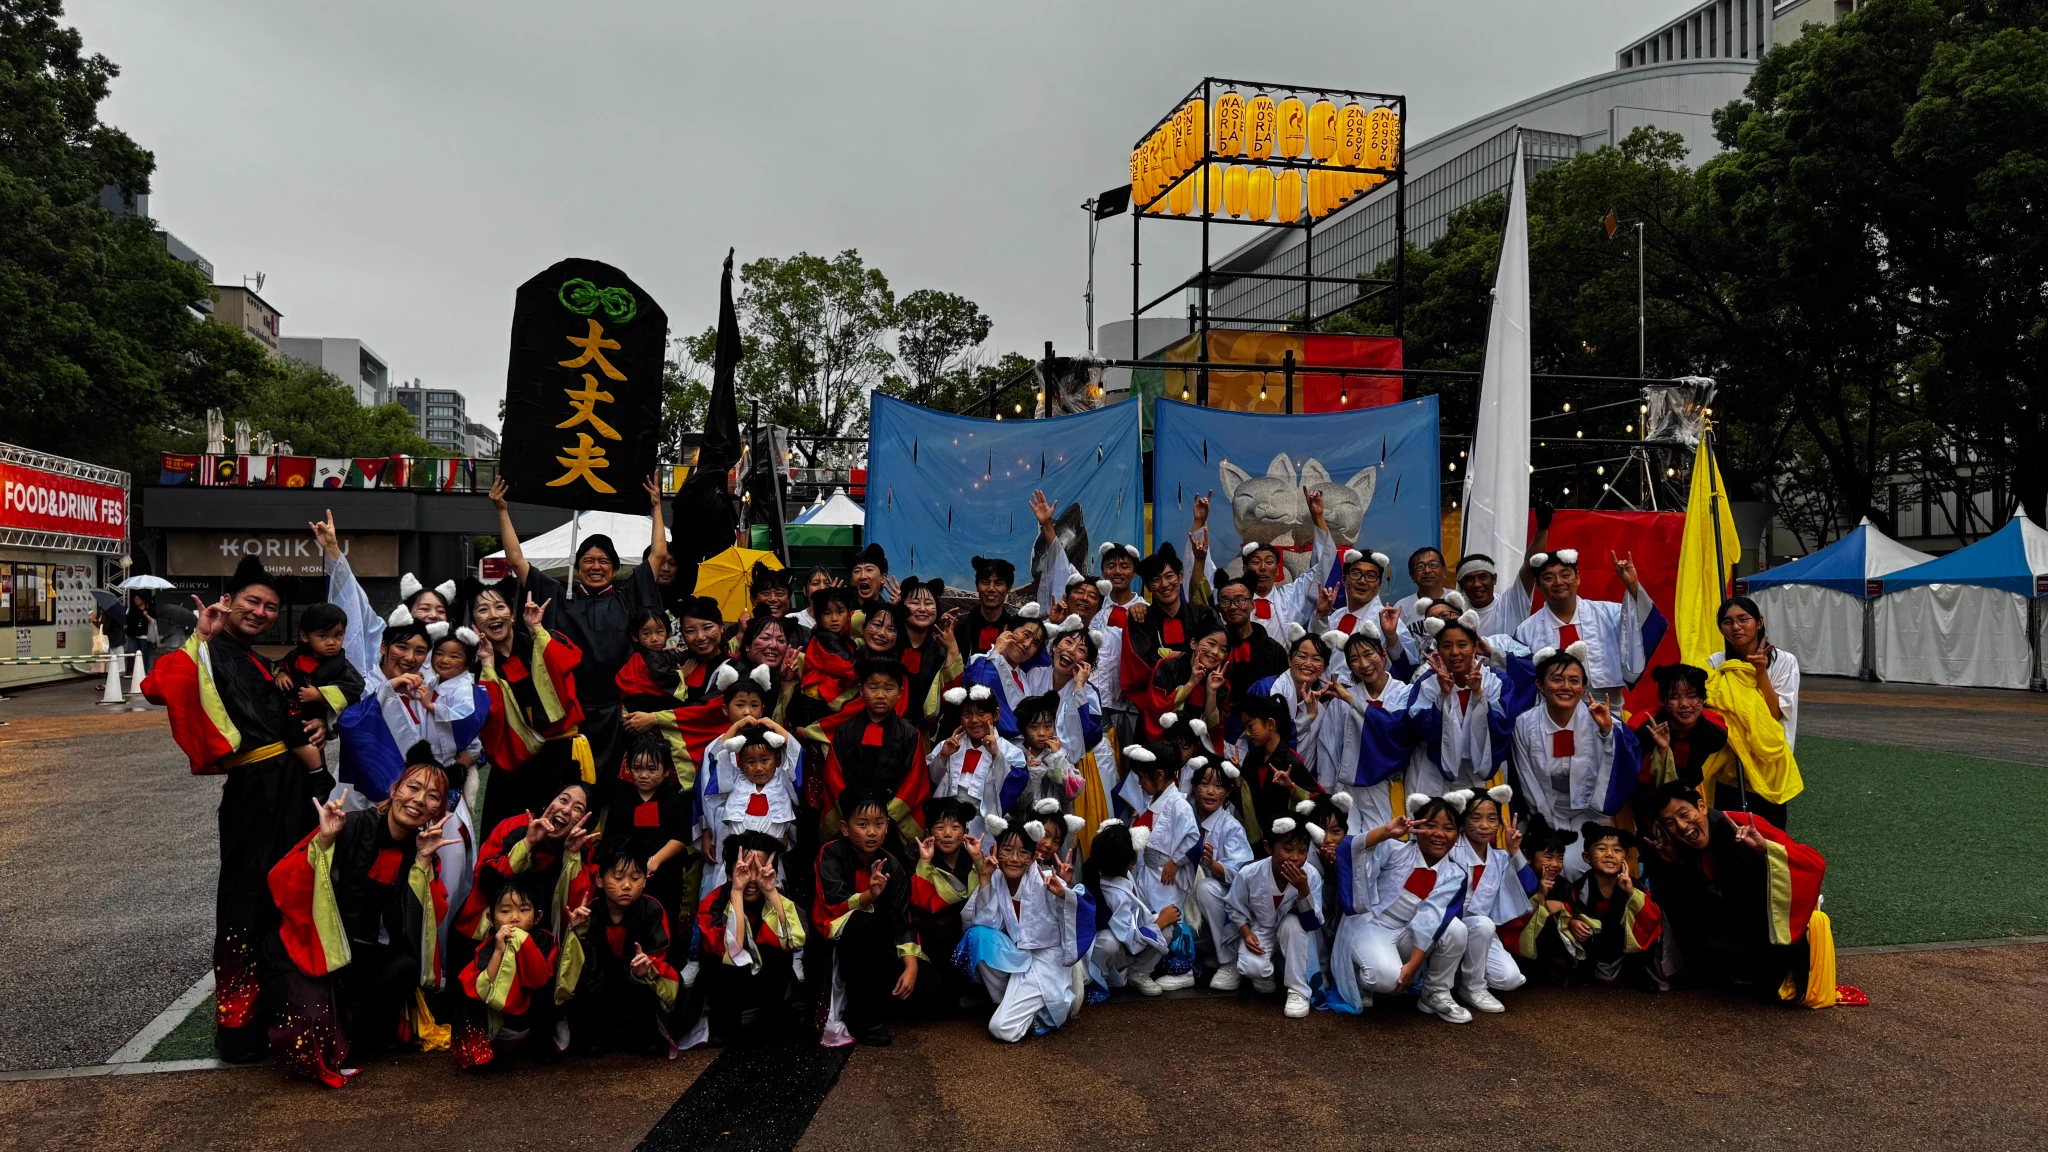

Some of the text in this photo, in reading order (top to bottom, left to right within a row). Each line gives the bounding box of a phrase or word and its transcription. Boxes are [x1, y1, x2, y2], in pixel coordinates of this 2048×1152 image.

[1220, 98, 1230, 151] WORLD
[1229, 98, 1240, 141] ASIA
[1254, 102, 1266, 152] WORLD
[1264, 102, 1274, 143] ASIA
[1346, 110, 1355, 147] 2026
[1354, 110, 1364, 160] Nagoya
[1371, 113, 1379, 149] 2026
[1380, 112, 1390, 161] Nagoya
[546, 318, 628, 494] 大丈夫
[5, 481, 122, 526] FOOD&DRINK FES
[263, 565, 325, 573] SHIMA MON
